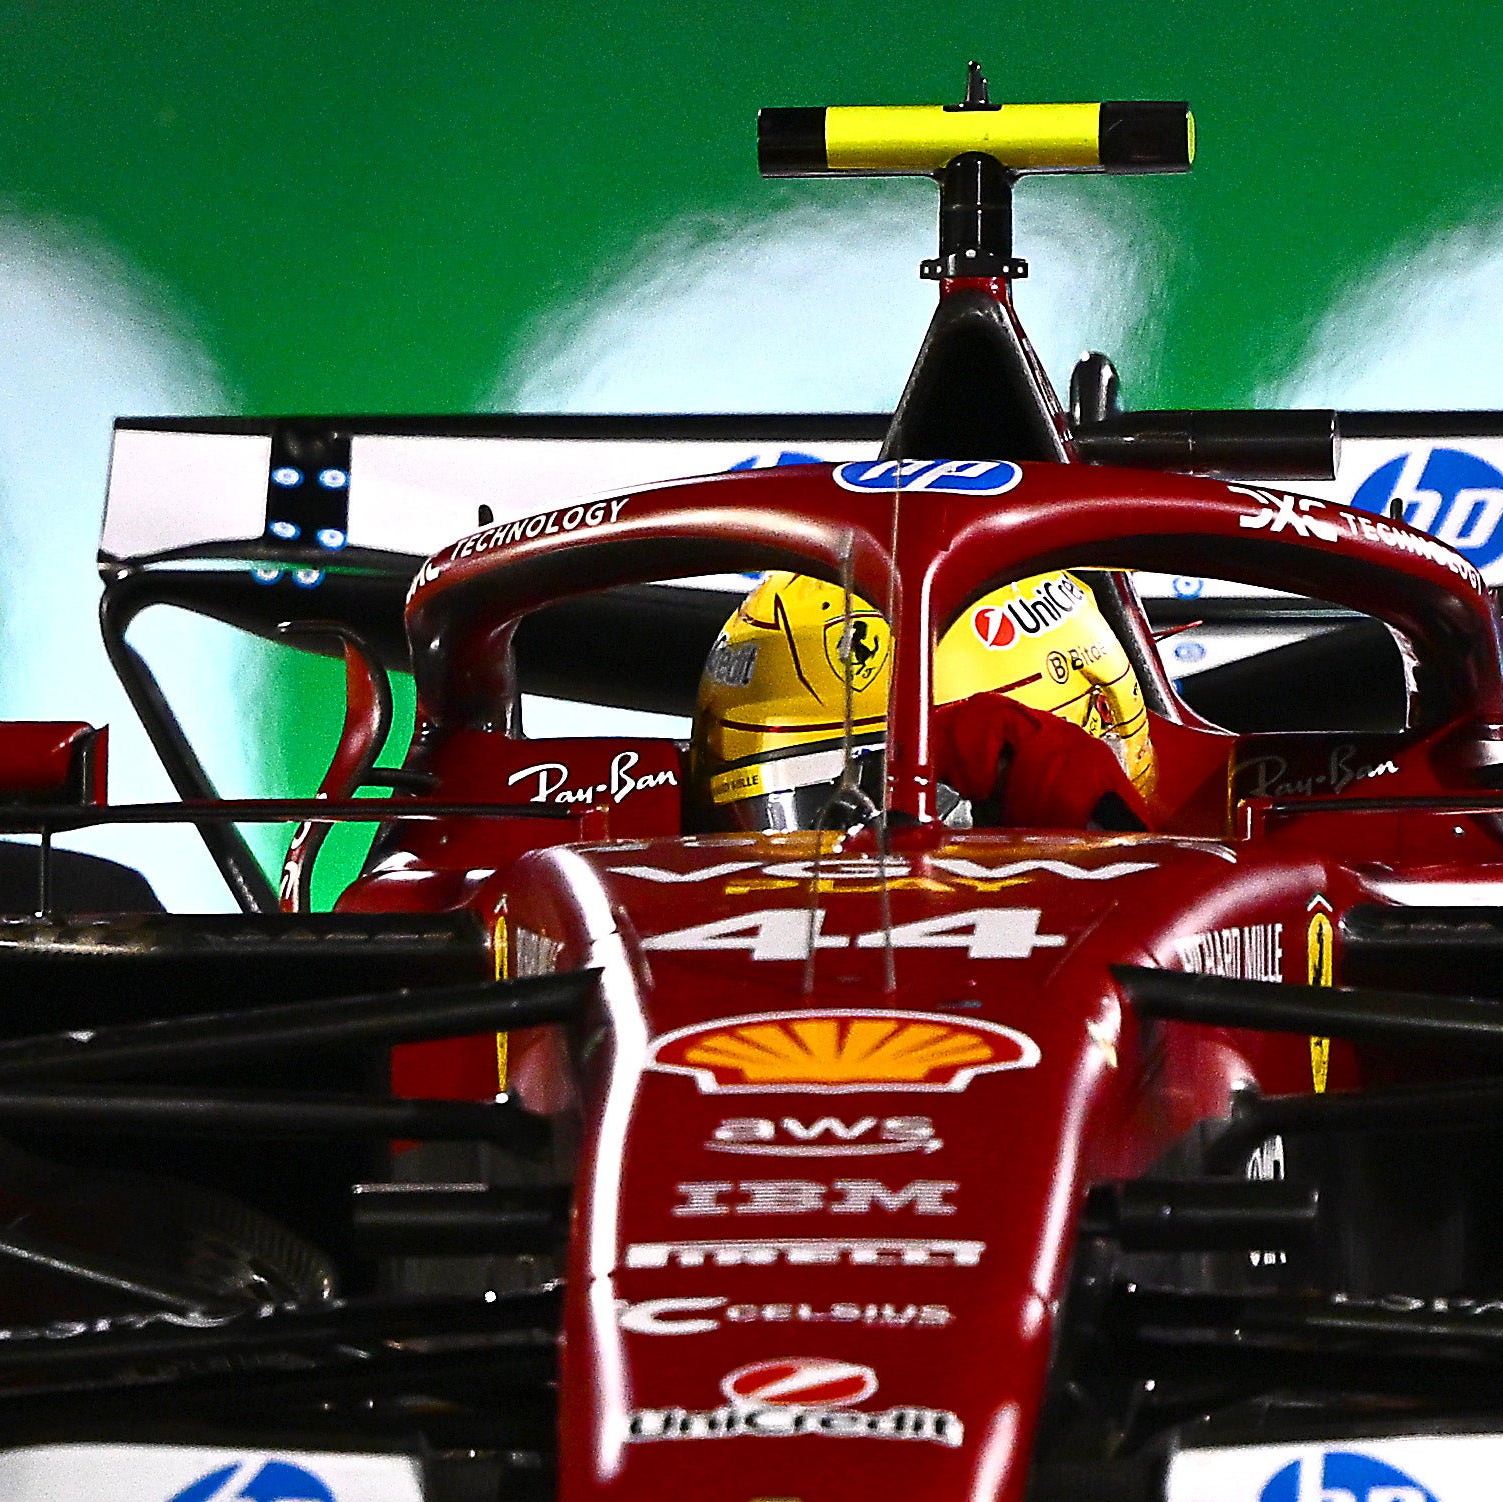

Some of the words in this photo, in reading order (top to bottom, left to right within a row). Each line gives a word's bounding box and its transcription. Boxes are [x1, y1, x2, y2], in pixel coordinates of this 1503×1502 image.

[450, 498, 629, 561] TECHNOLOGY
[640, 907, 1067, 961] 44
[1243, 923, 1283, 984] MILLE
[713, 1115, 937, 1142] aws
[670, 1179, 961, 1216] IBM
[625, 1237, 987, 1268] PIRELLI
[628, 1406, 961, 1446] UniCredit
